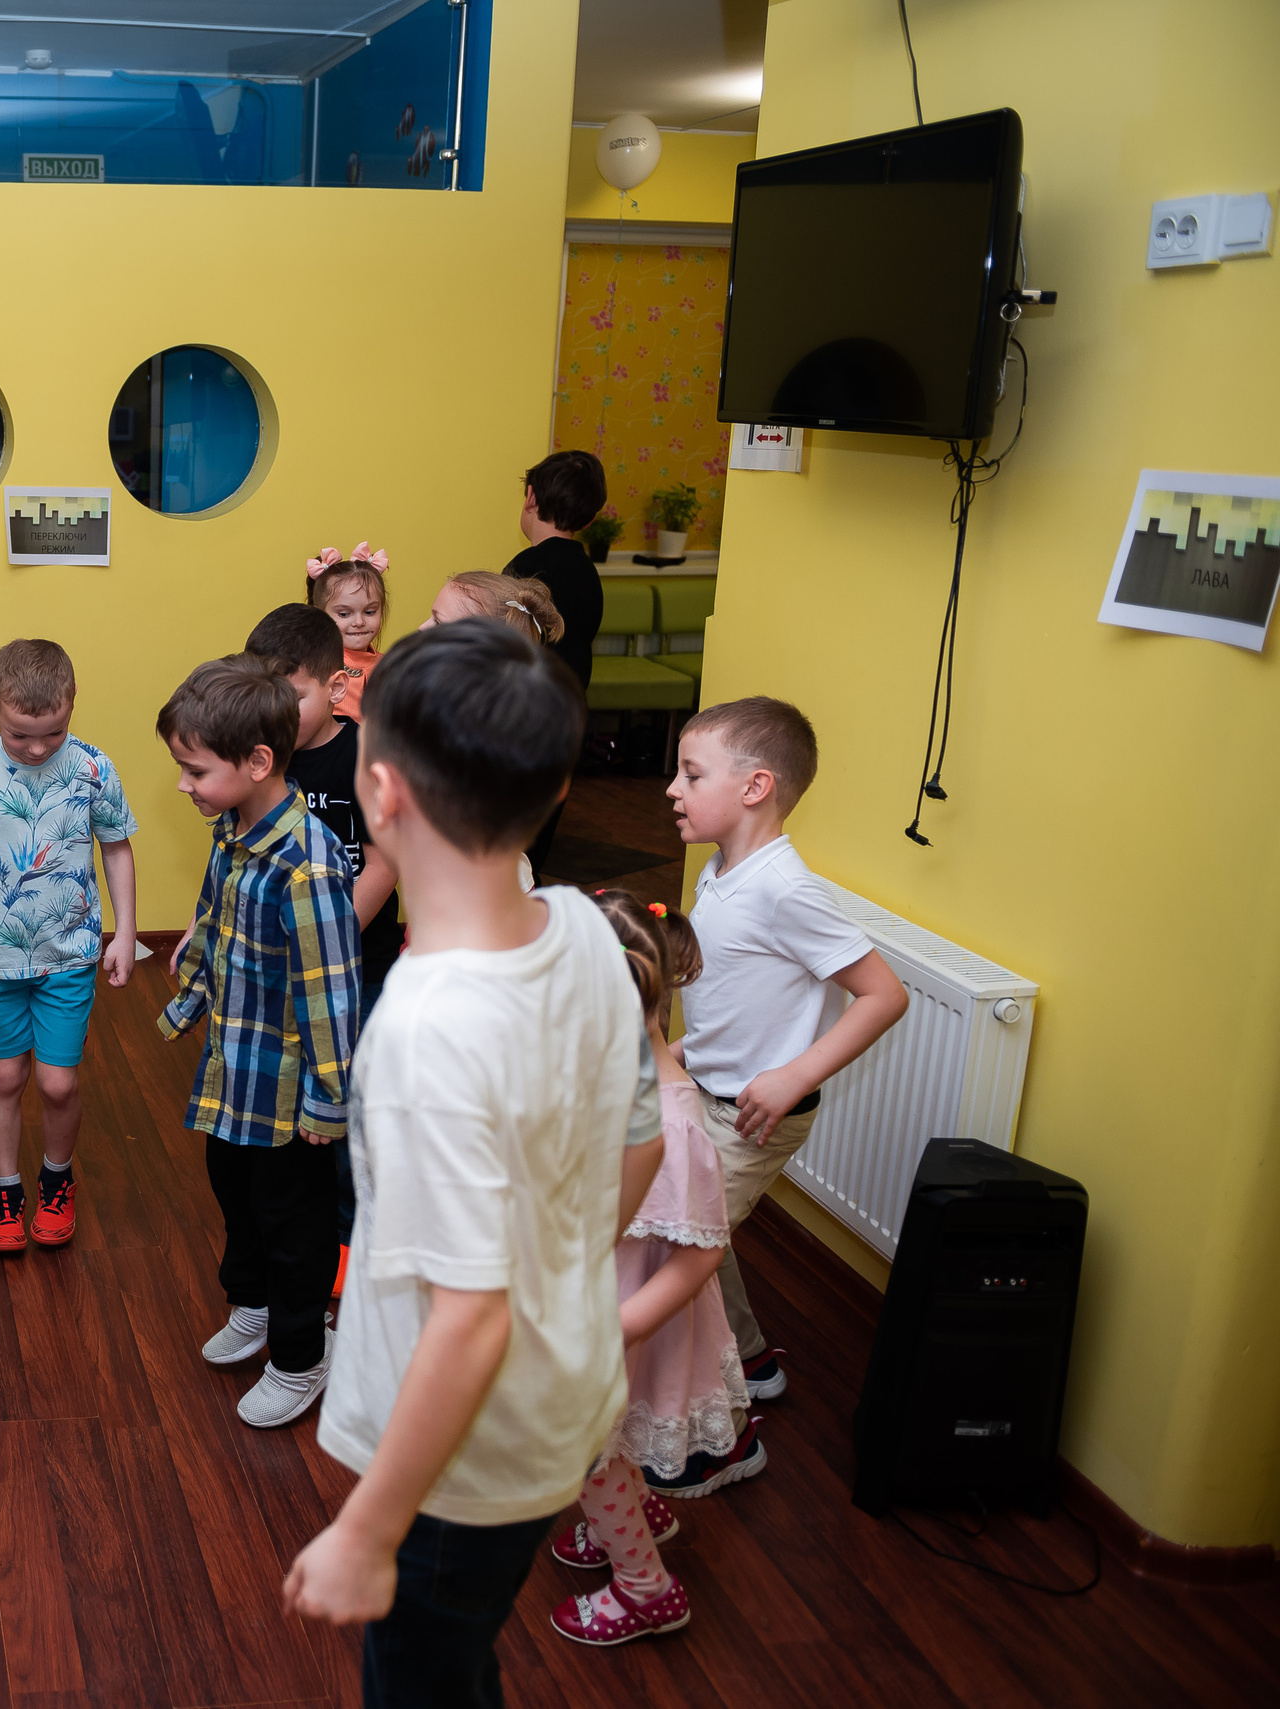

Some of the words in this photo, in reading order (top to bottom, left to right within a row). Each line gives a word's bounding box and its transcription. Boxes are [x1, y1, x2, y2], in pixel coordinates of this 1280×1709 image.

[31, 160, 96, 178] ВЫХОД
[30, 532, 87, 541] ПЕРЕКЛЮЧИ
[41, 545, 75, 553] РЕЖИМ
[1191, 568, 1229, 590] ЛАВА
